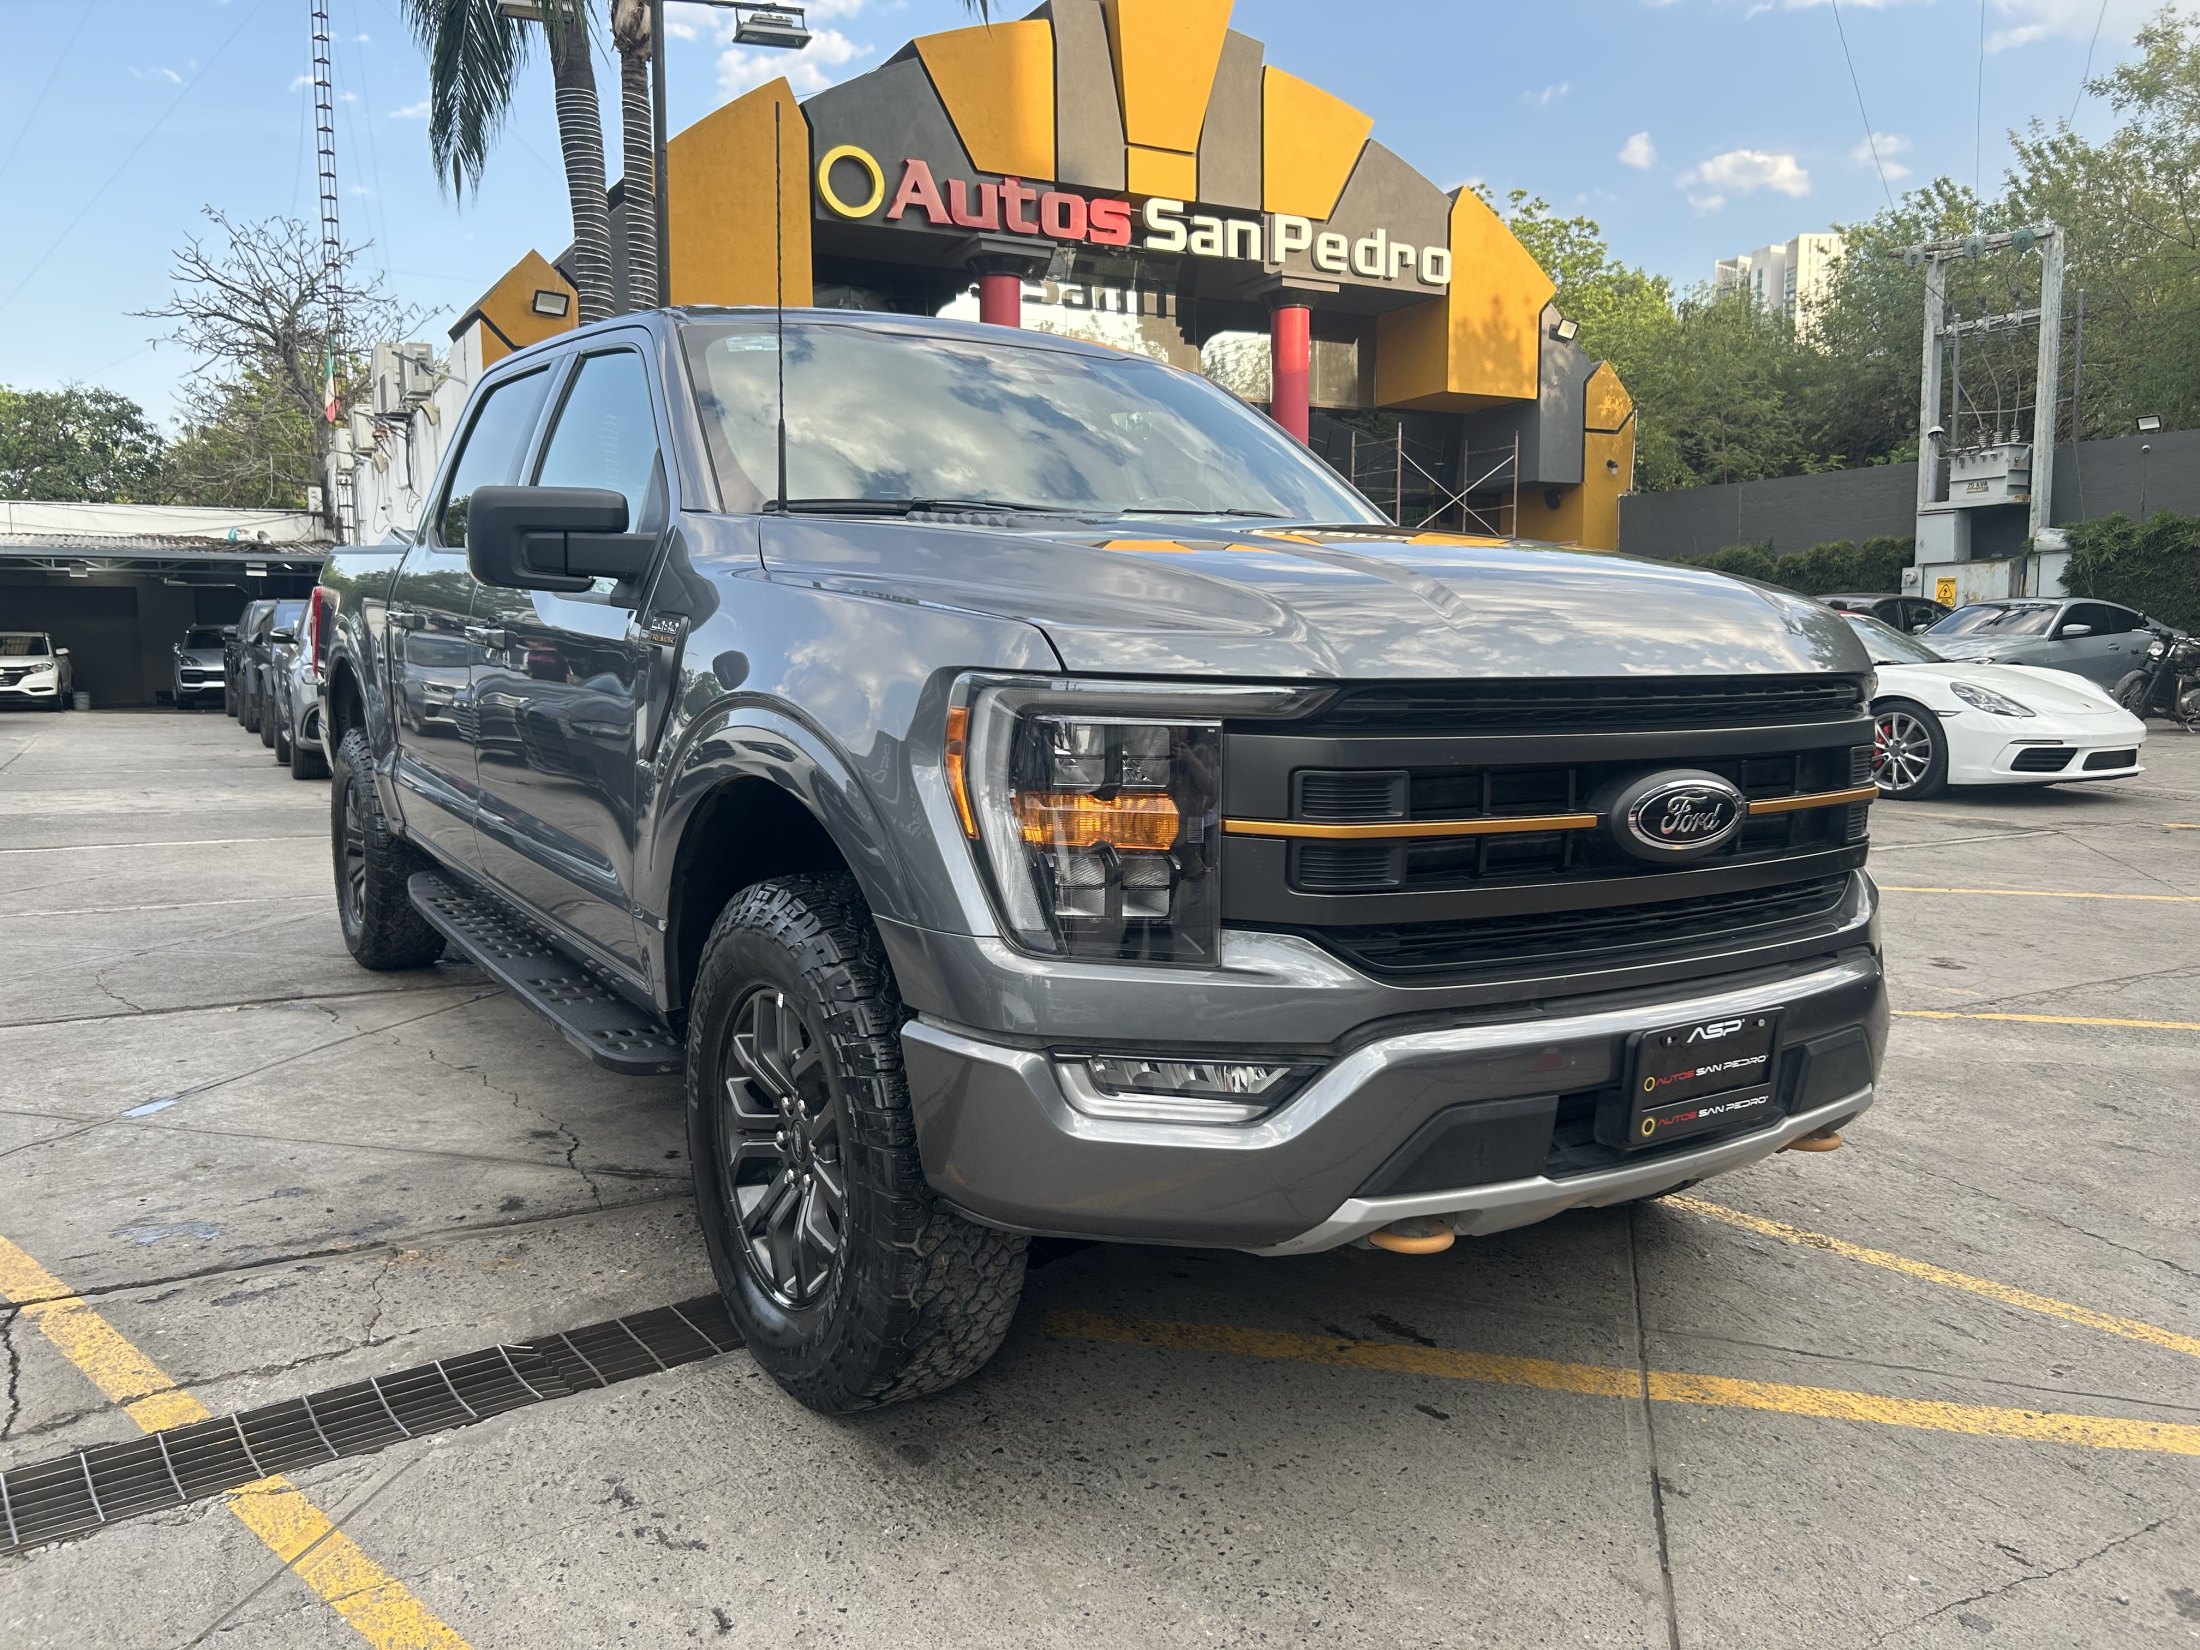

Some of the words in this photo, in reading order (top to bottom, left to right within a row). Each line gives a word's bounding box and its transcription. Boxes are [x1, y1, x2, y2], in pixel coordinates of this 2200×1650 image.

[886, 158, 1132, 247] Autos
[1143, 197, 1262, 262] San
[1269, 212, 1452, 286] Pedro
[1660, 796, 1723, 835] Ford
[1686, 1019, 1743, 1043] ASP
[1655, 1069, 1696, 1086] AUTOS
[1696, 1063, 1723, 1076] SAN
[1723, 1055, 1767, 1069] PEDRO
[1657, 1111, 1698, 1127] AUTOS
[1698, 1105, 1725, 1118] SAN
[1726, 1096, 1767, 1111] PEDRO
